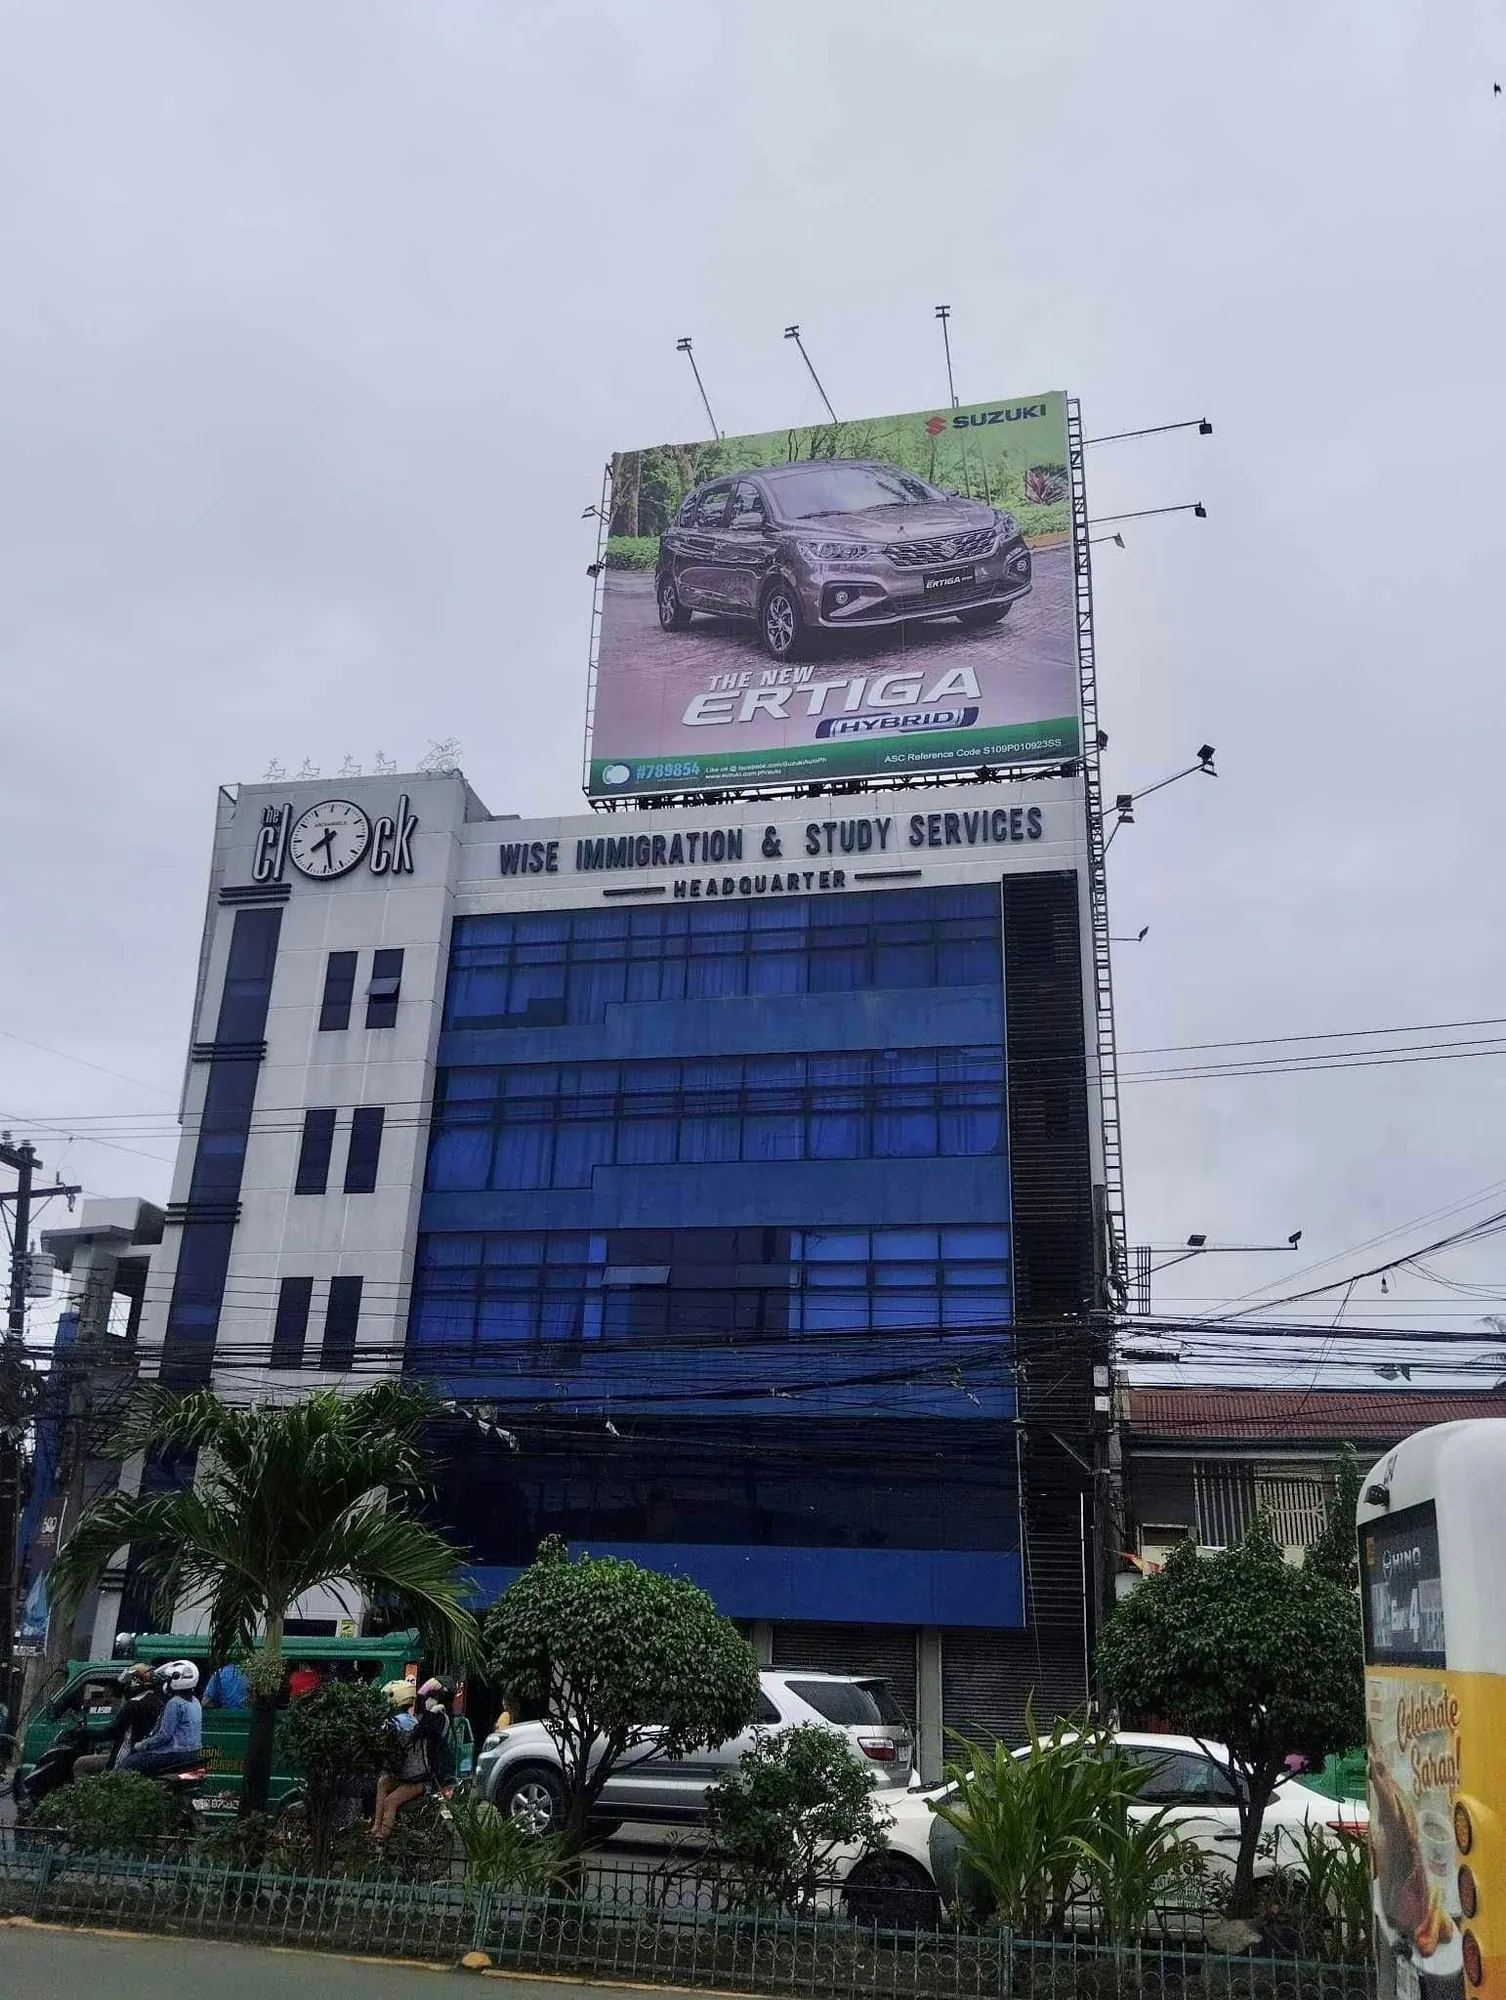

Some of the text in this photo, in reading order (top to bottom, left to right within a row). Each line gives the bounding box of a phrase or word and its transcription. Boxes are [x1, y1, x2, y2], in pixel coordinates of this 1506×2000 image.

[952, 404, 1046, 429] SUZUKI
[926, 576, 961, 589] ERTIGA
[708, 665, 817, 692] THE NEW
[682, 666, 983, 726] ERTIGA
[840, 711, 955, 734] HYBRID
[884, 738, 1062, 764] ASC Reference Code S109P010923SS
[262, 804, 283, 826] the
[500, 807, 1043, 875] WISE IMMIGRATION & STUDY SERVICES
[673, 869, 846, 898] HEADQUARTER
[1392, 1546, 1421, 1566] HINO
[1397, 1688, 1460, 1752] Celebrate
[1411, 1736, 1461, 1804] Sarap!
